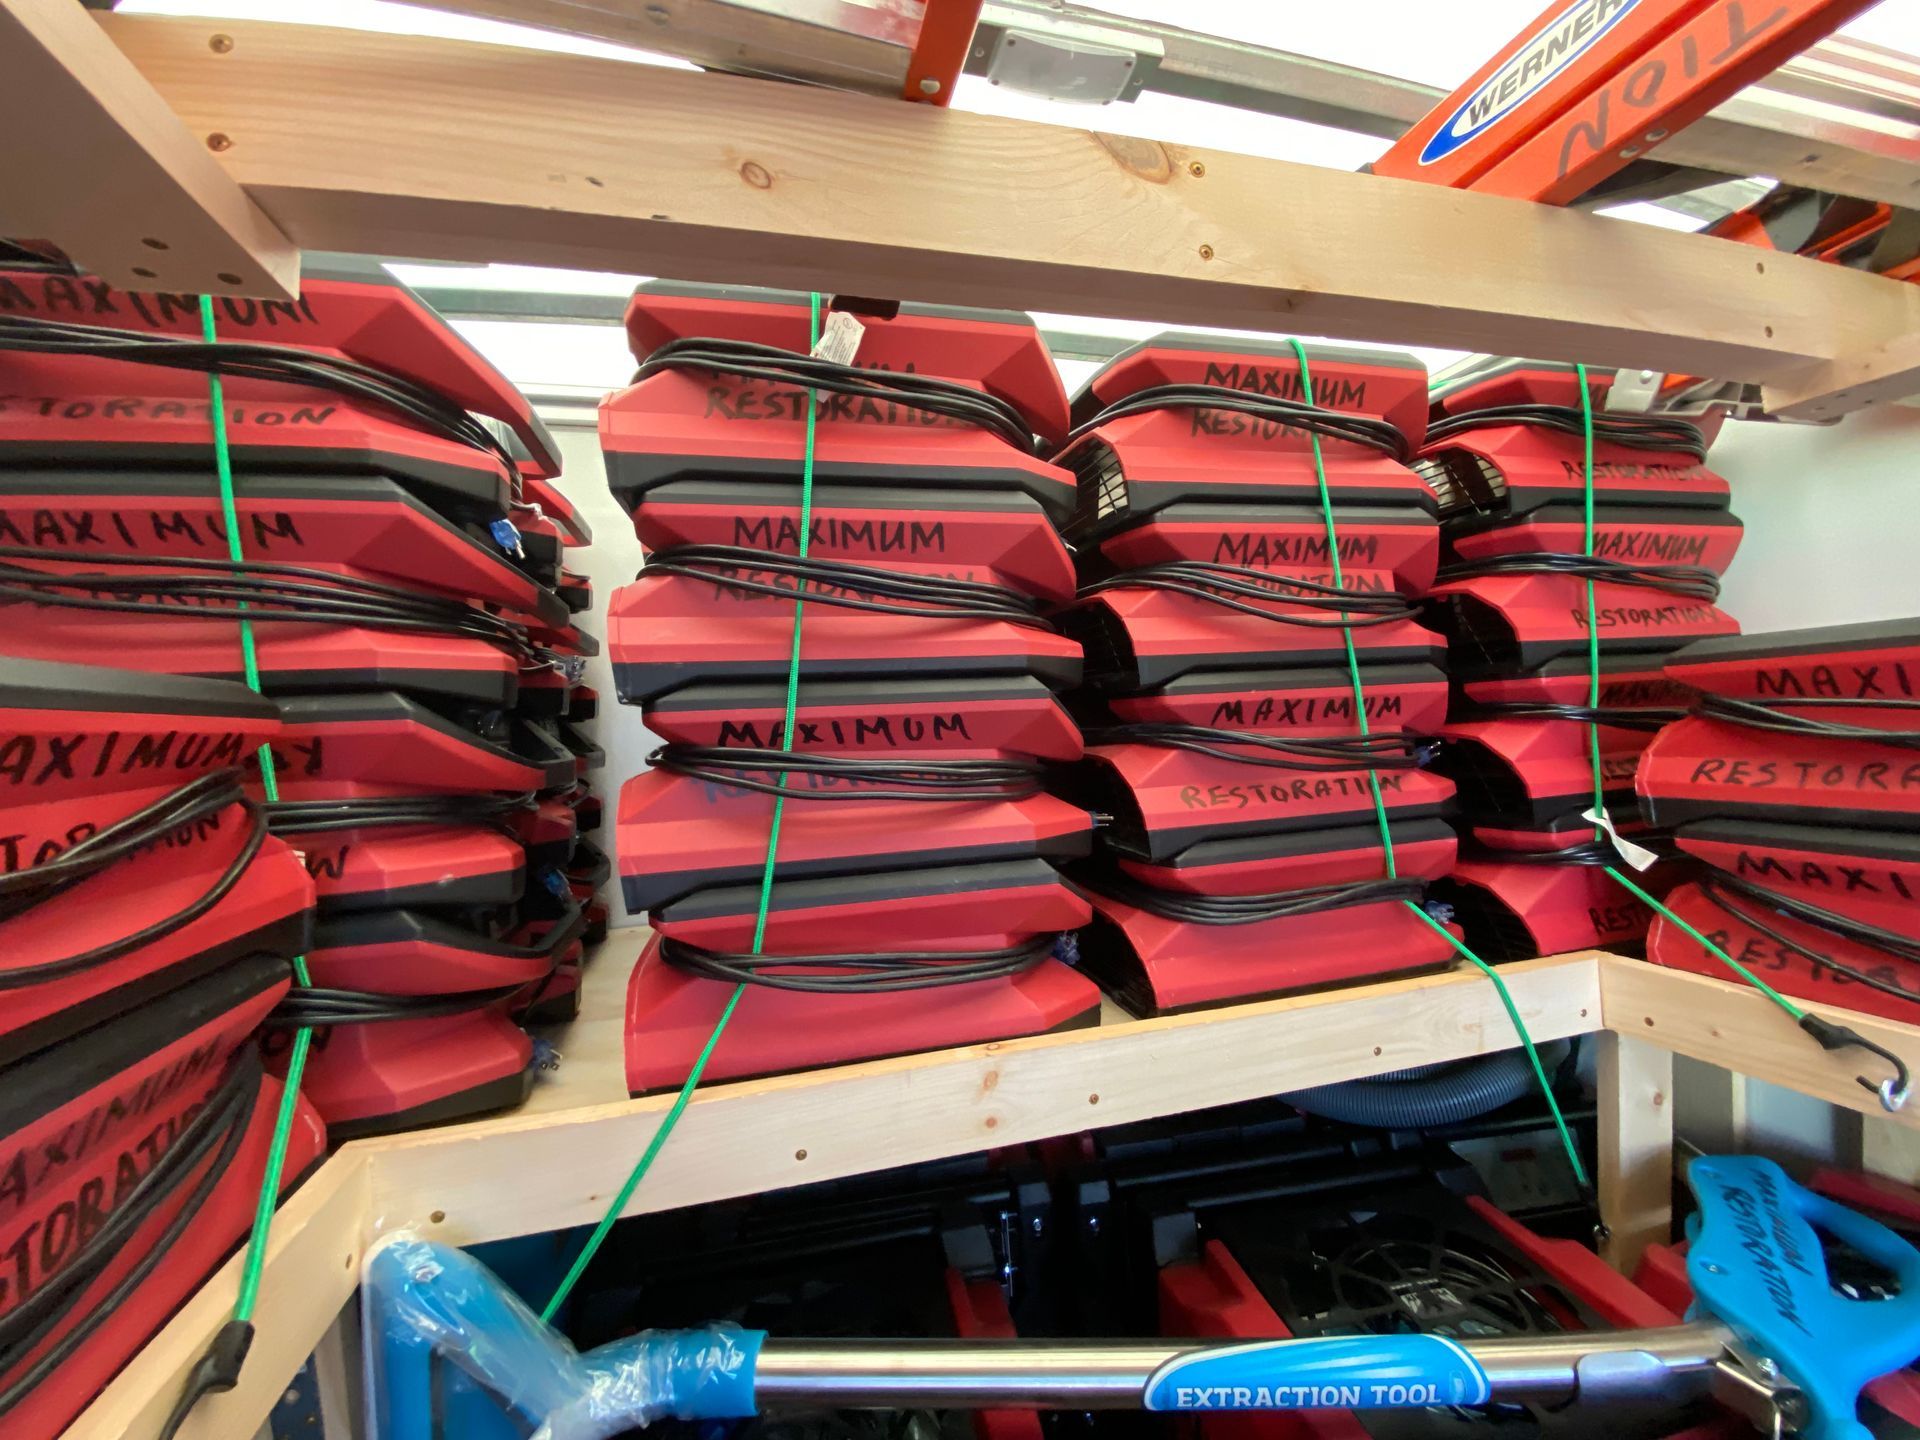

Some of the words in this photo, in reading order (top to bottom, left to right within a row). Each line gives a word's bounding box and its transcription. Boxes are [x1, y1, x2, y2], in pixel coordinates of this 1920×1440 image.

[1203, 362, 1366, 408] MAXIMUM
[734, 515, 944, 554] MAXIMUM
[1213, 533, 1378, 568] MAXIMUM
[1756, 663, 1912, 697] MAXI
[1211, 697, 1401, 726] MAXIMUM
[1737, 851, 1913, 900] MAXI
[1176, 1385, 1361, 1407] EXTRACTION
[1370, 1384, 1442, 1404] TOOL
